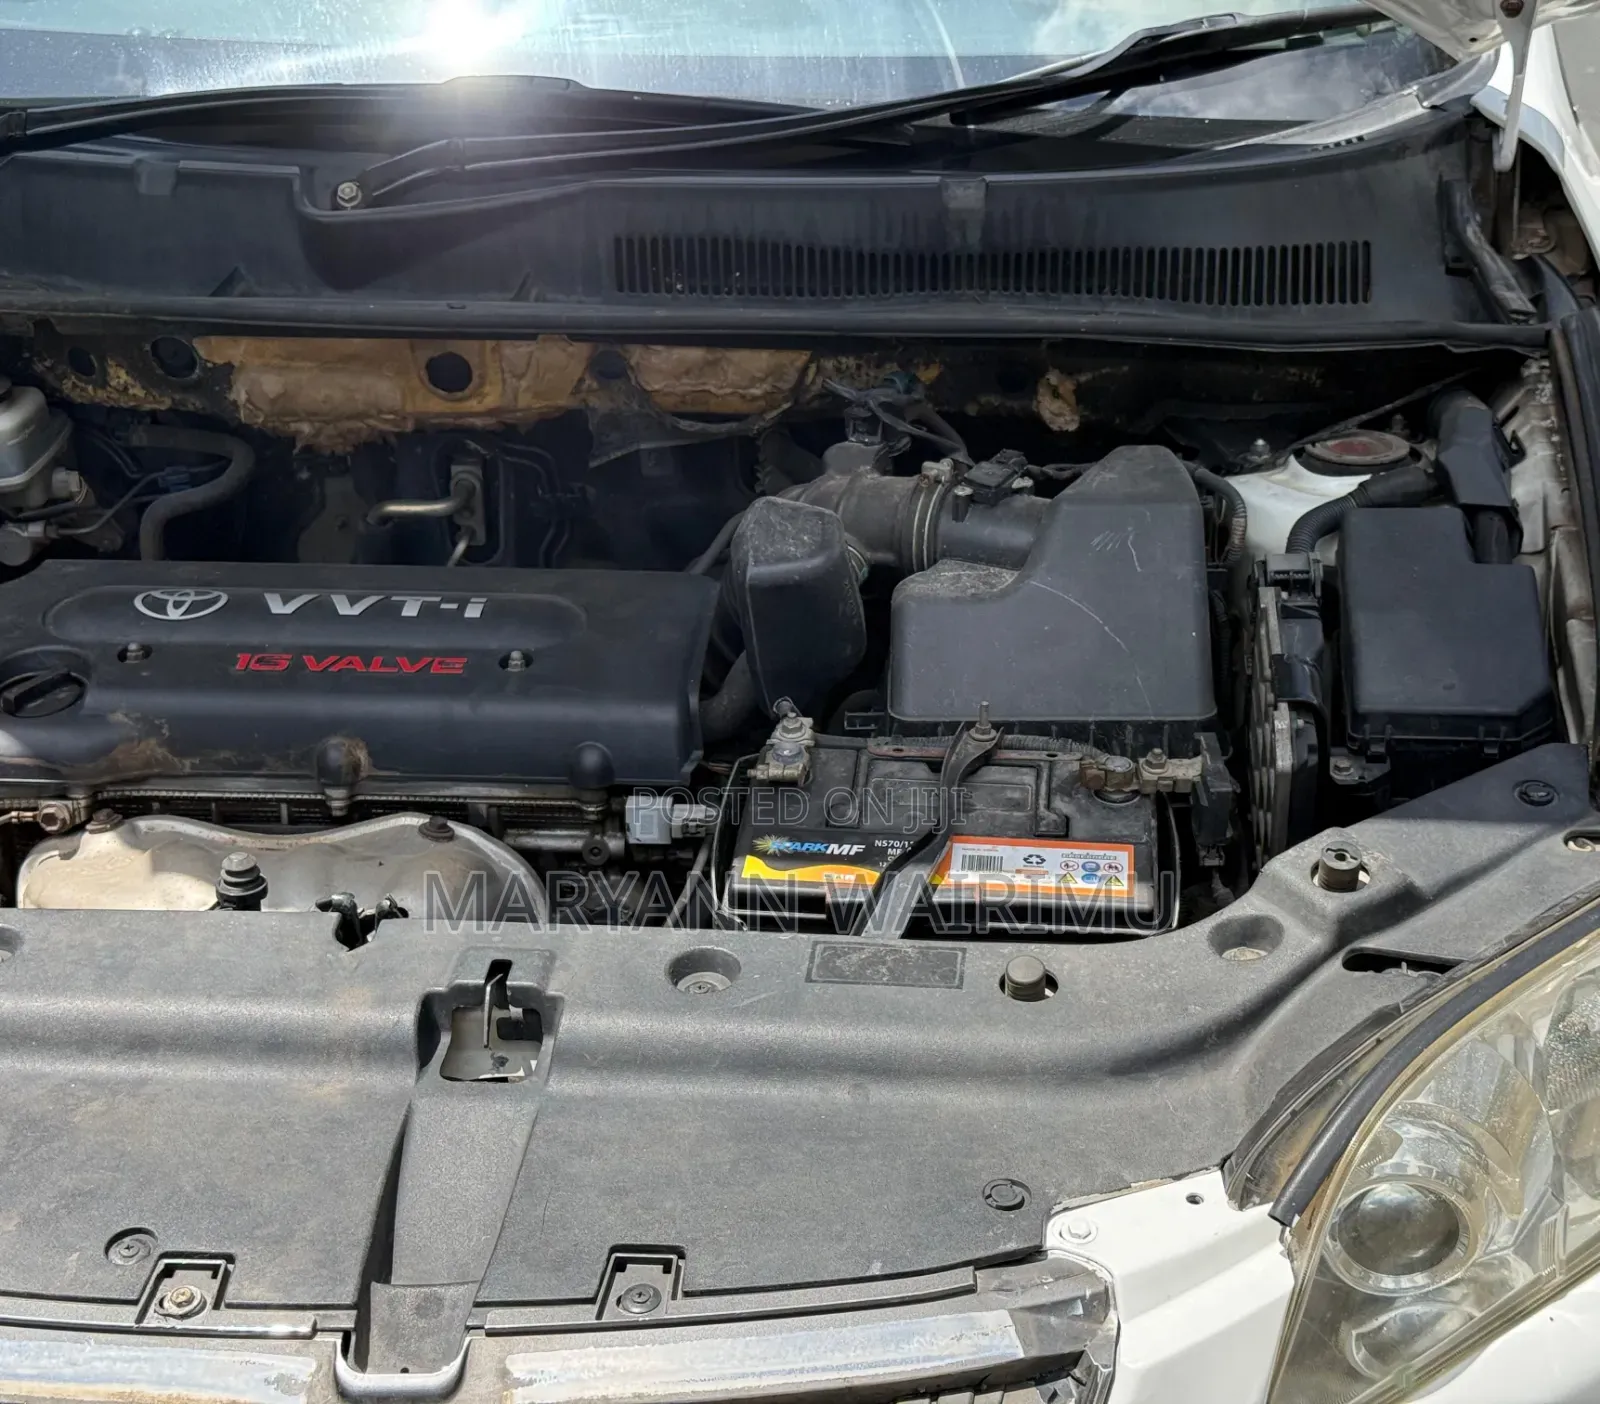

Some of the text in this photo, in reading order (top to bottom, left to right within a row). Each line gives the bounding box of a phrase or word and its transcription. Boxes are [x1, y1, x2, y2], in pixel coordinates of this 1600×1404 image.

[263, 592, 487, 619] VVT-i
[236, 652, 468, 674] 16 VALVE
